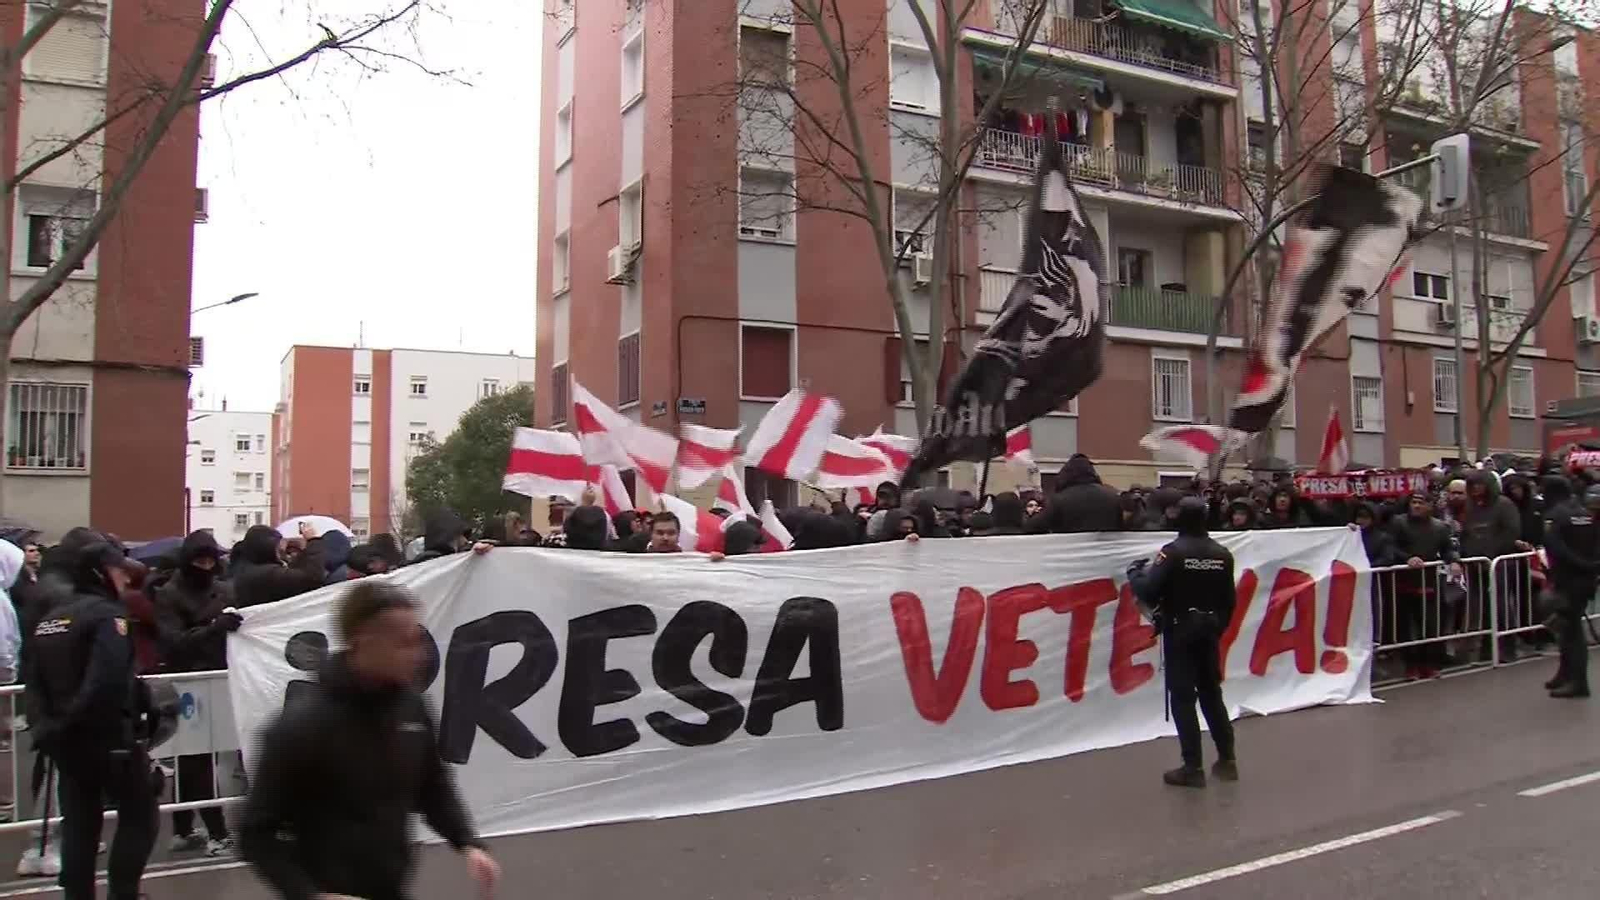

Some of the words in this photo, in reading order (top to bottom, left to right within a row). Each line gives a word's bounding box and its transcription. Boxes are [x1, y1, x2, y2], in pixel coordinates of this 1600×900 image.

[1300, 476, 1348, 495] PRESA
[1369, 475, 1405, 493] VETE
[285, 596, 844, 764] RESA
[889, 577, 1158, 725] VETE
